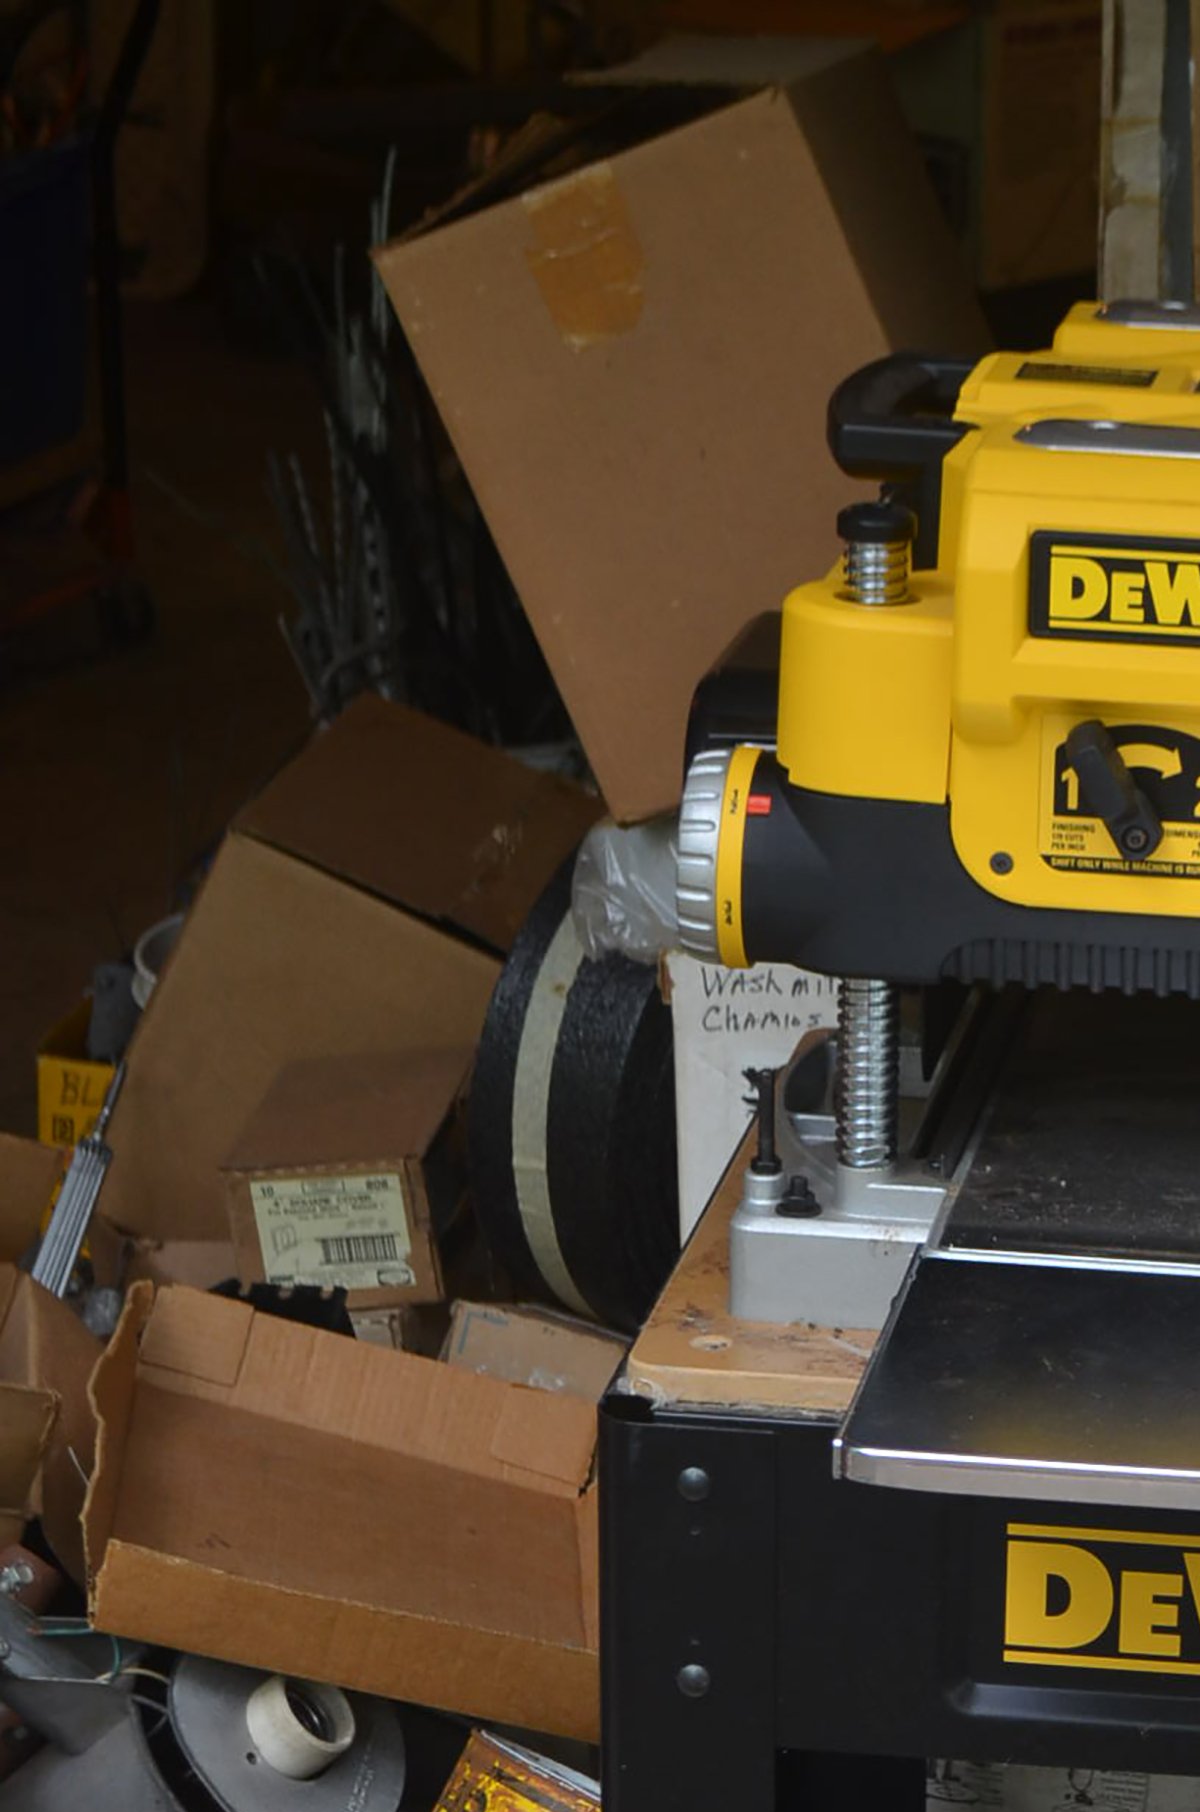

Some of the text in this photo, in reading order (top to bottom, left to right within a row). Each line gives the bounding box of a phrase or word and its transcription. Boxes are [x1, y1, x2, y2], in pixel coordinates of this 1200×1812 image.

[1061, 766, 1080, 811] 1
[1076, 859, 1101, 870] ONLY
[1102, 860, 1130, 871] WHILE
[1131, 861, 1173, 873] MACHINE
[1174, 864, 1185, 874] IS
